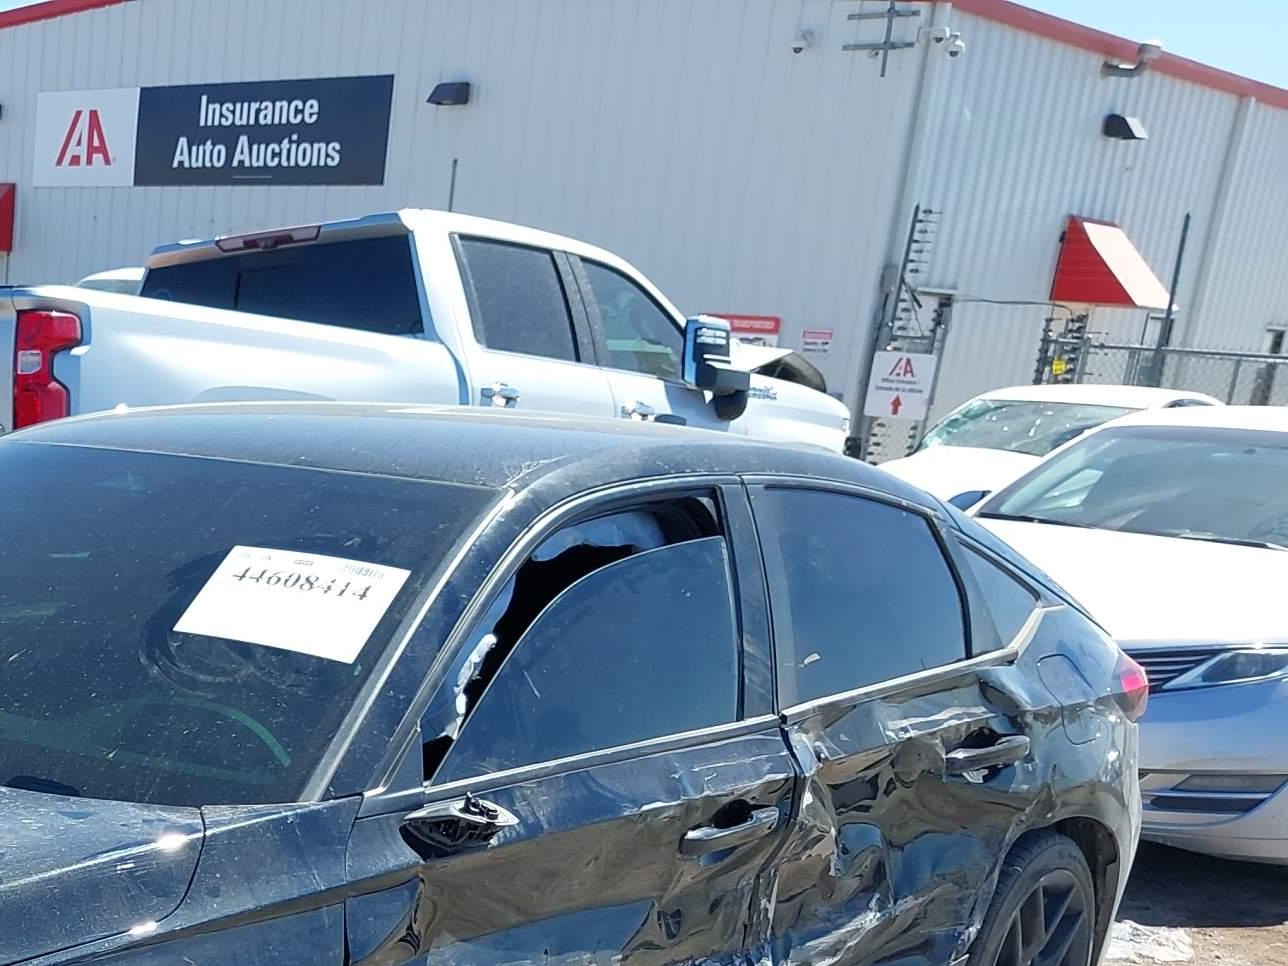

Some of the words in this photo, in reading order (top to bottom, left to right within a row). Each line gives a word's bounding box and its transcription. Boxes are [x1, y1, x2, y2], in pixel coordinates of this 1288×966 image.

[199, 94, 319, 127] Insurance
[172, 136, 227, 168] Auto
[231, 133, 341, 167] Auctions
[232, 566, 372, 601] 44608414
